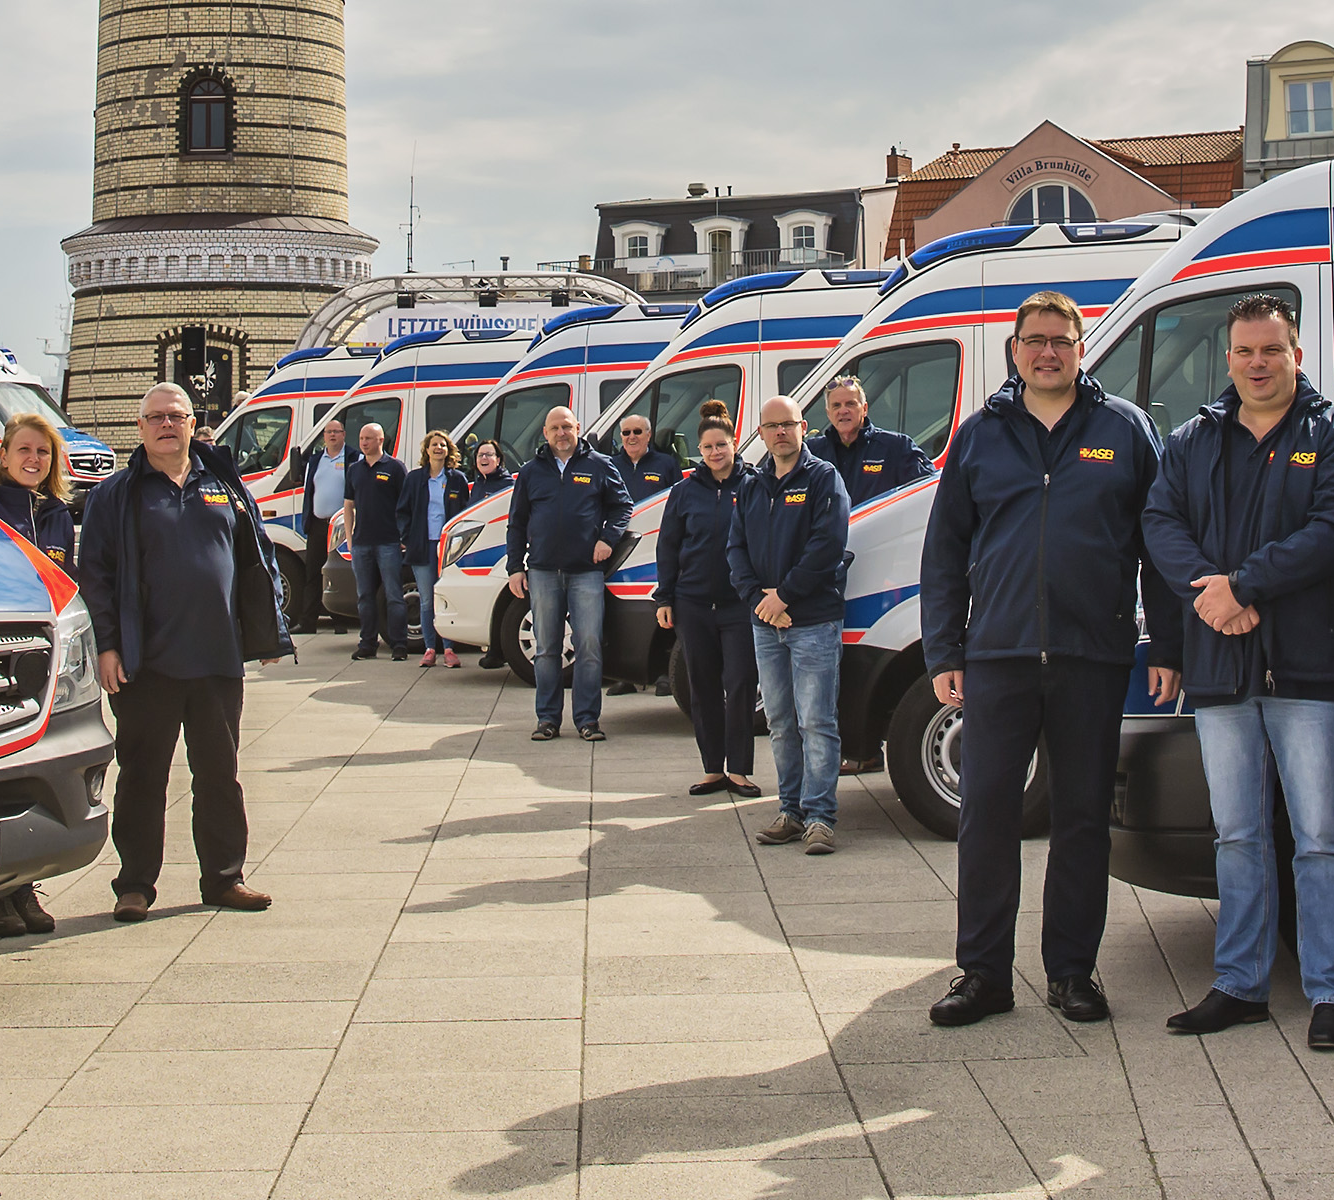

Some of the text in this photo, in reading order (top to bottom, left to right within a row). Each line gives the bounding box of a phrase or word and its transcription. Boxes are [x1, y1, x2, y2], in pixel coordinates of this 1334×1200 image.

[1005, 160, 1092, 185] Villa Brunhilde
[388, 317, 448, 338] LETZTE
[1088, 448, 1115, 460] ASB
[1290, 452, 1317, 464] ASB
[211, 494, 229, 504] ASB
[790, 493, 807, 503] ASB
